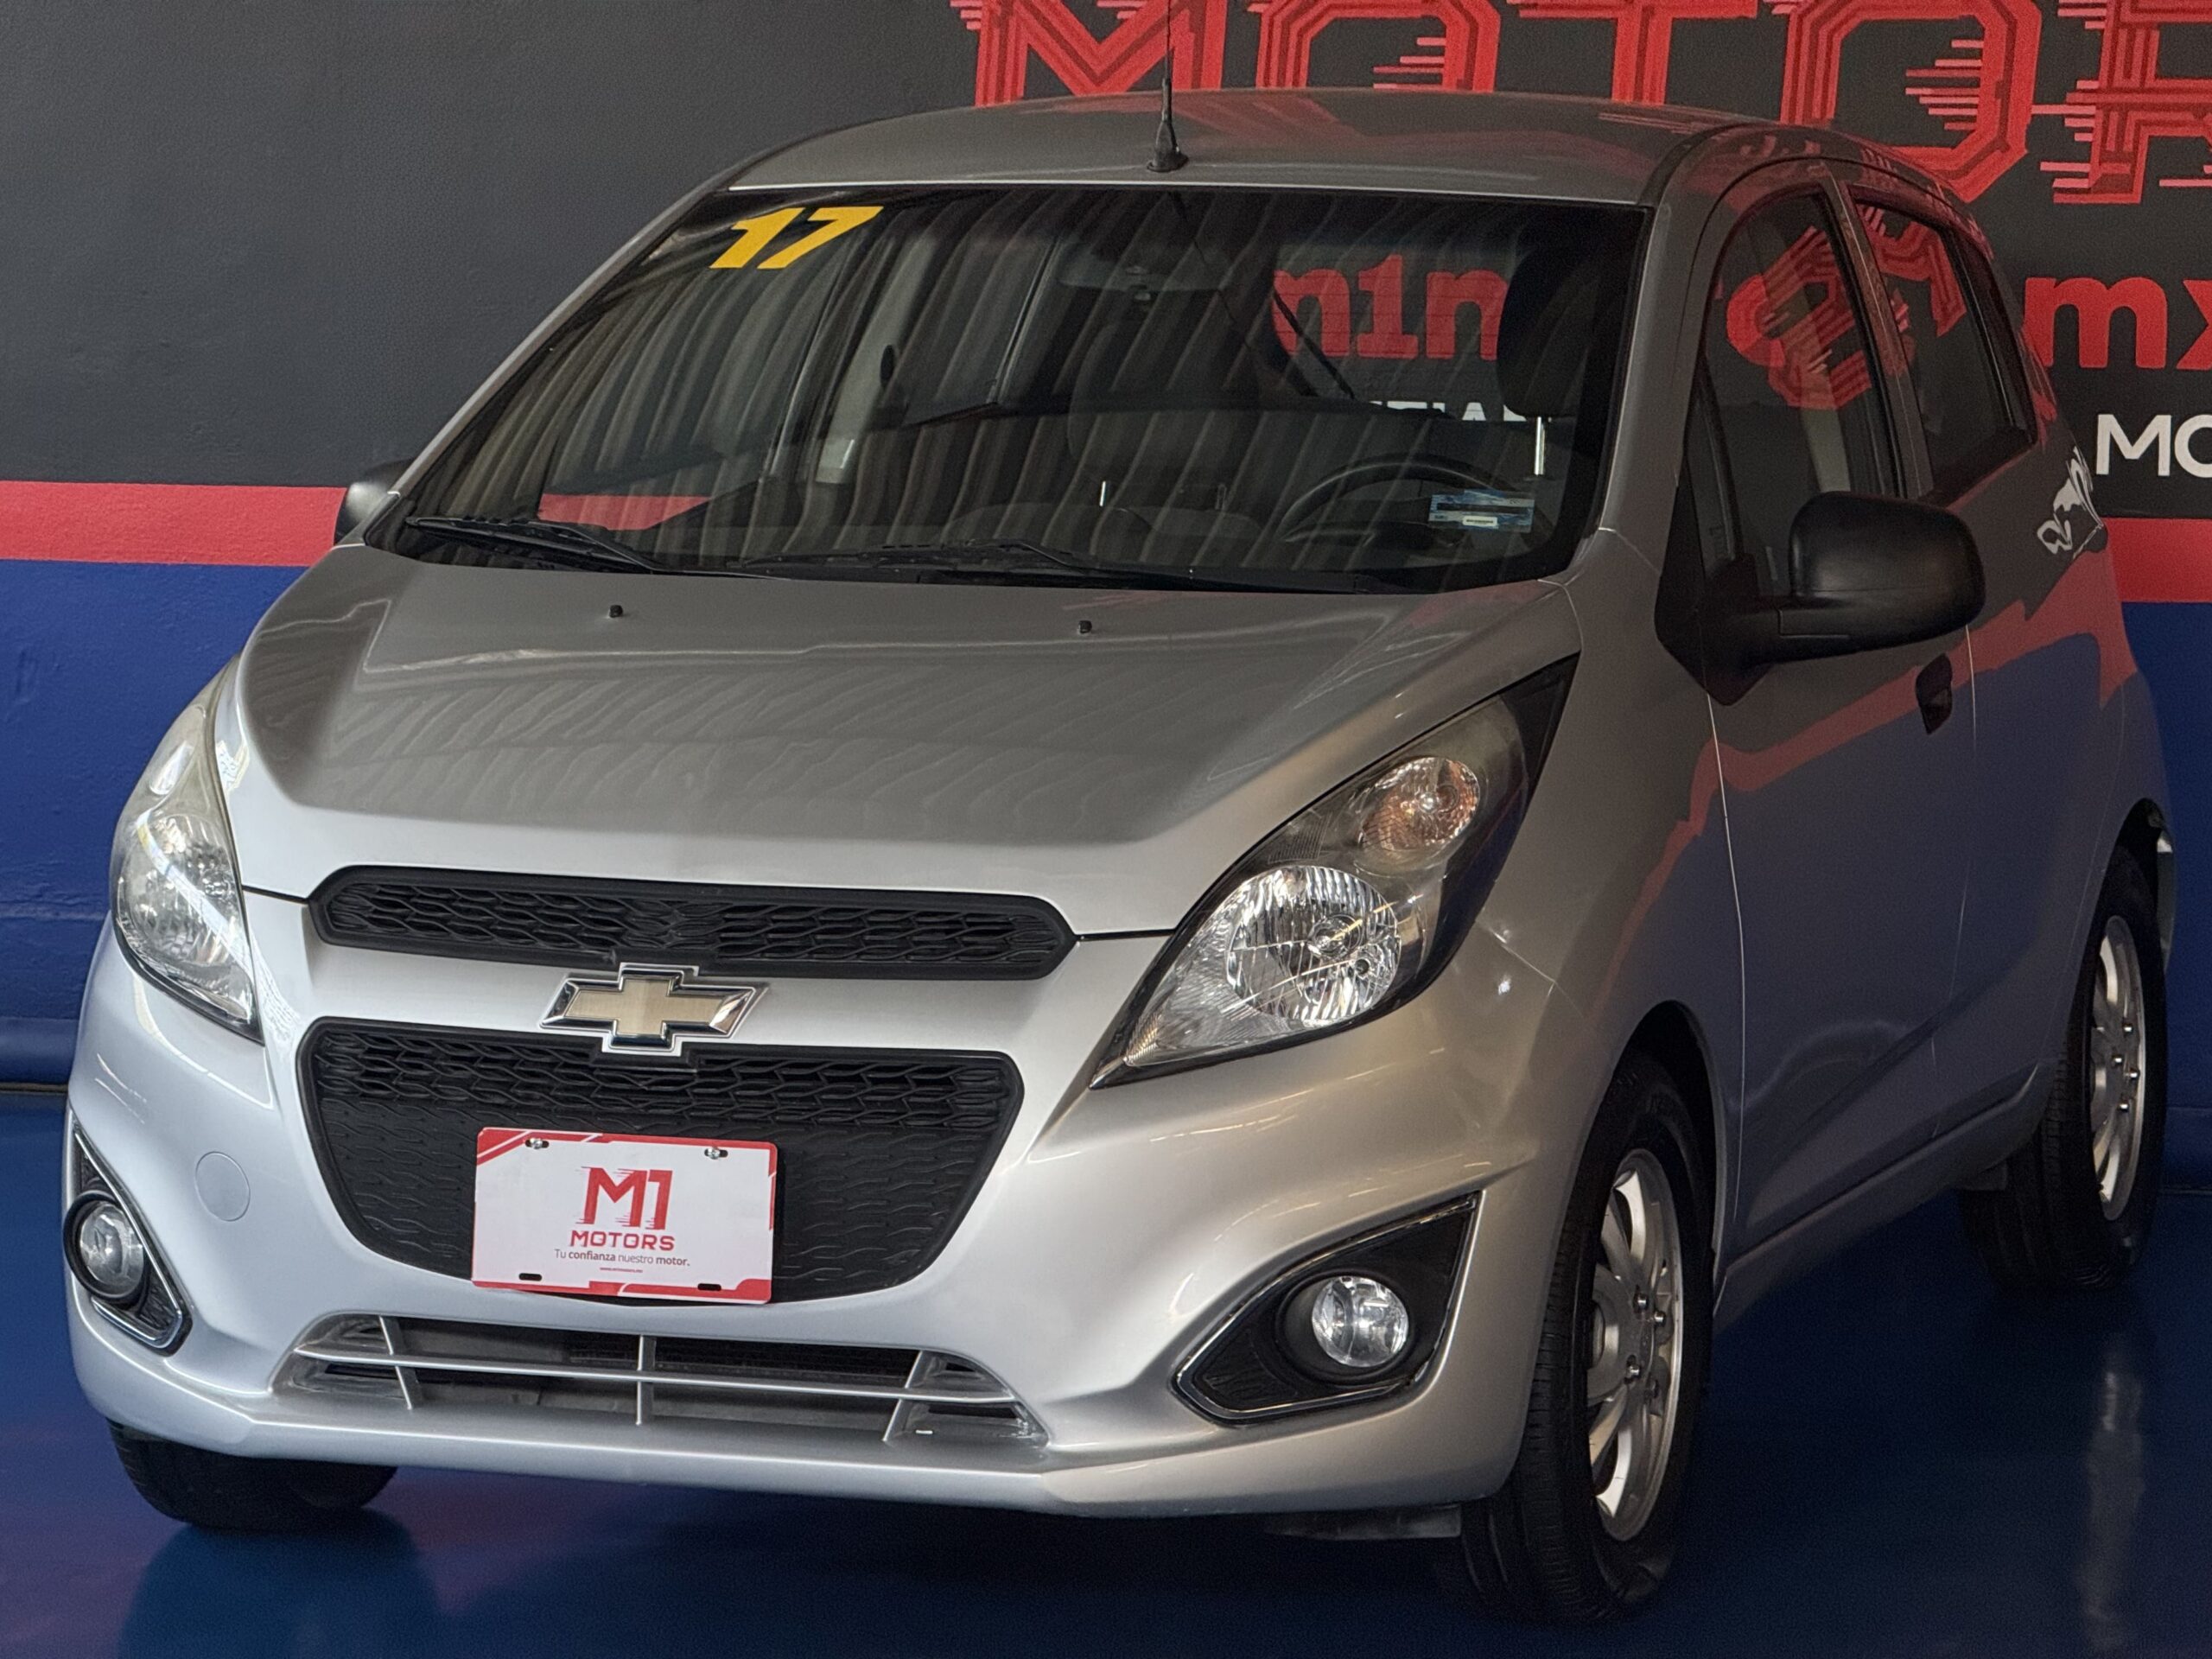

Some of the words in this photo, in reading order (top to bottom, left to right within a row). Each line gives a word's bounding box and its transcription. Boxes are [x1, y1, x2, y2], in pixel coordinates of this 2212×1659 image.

[709, 206, 885, 270] 17
[577, 1166, 673, 1230] M1
[554, 1249, 567, 1259] Tu
[568, 1250, 616, 1262] confianza
[618, 1254, 654, 1264] nuestro
[655, 1256, 690, 1267] motor.
[569, 1230, 676, 1251] MOTORS
